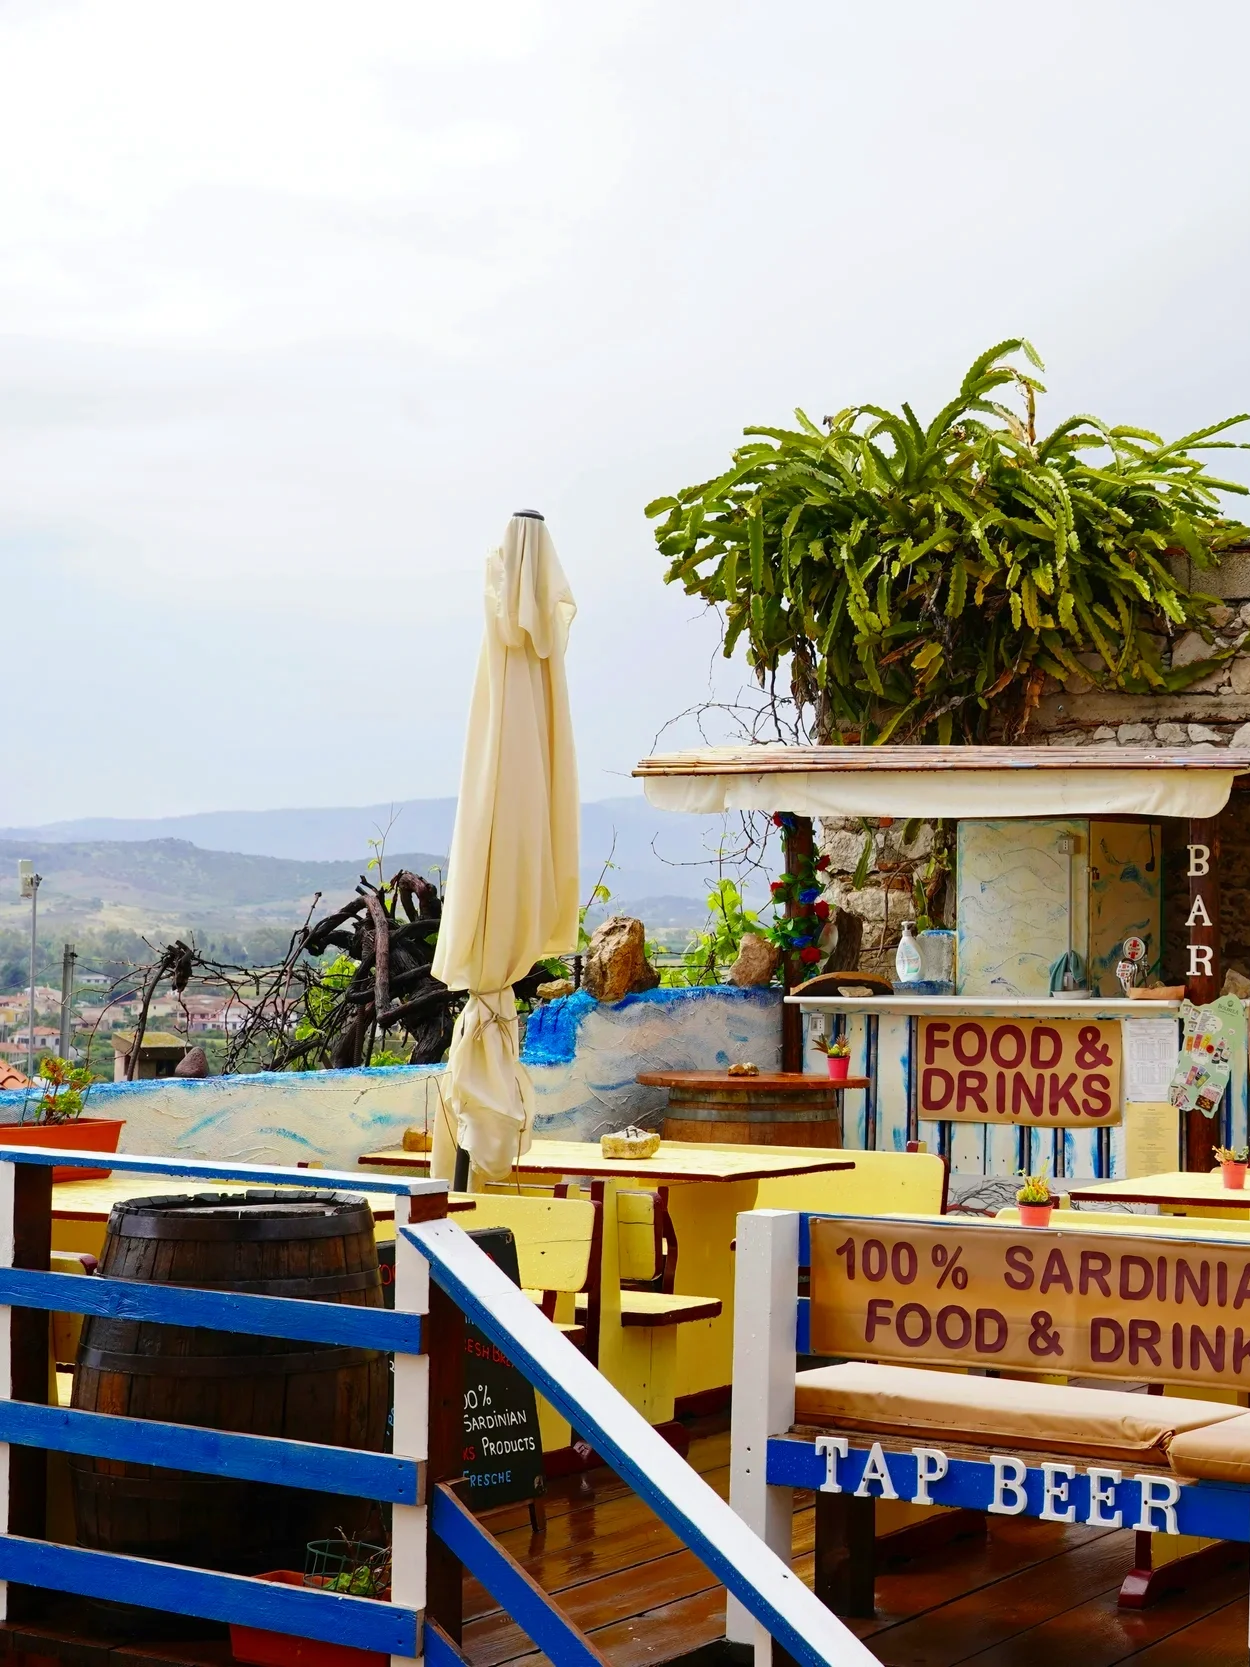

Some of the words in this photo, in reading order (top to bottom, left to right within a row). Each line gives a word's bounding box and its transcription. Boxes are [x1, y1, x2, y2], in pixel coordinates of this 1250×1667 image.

[1185, 845, 1213, 976] BAR
[925, 1022, 1063, 1069] FOOD
[1075, 1024, 1113, 1067] &
[921, 1067, 1112, 1118] DRINKS
[865, 1298, 1009, 1354] FOOD
[1029, 1310, 1063, 1357] &
[482, 1437, 535, 1456] PRODUCTS
[814, 1436, 949, 1505] TAP
[988, 1455, 1181, 1535] BEER
